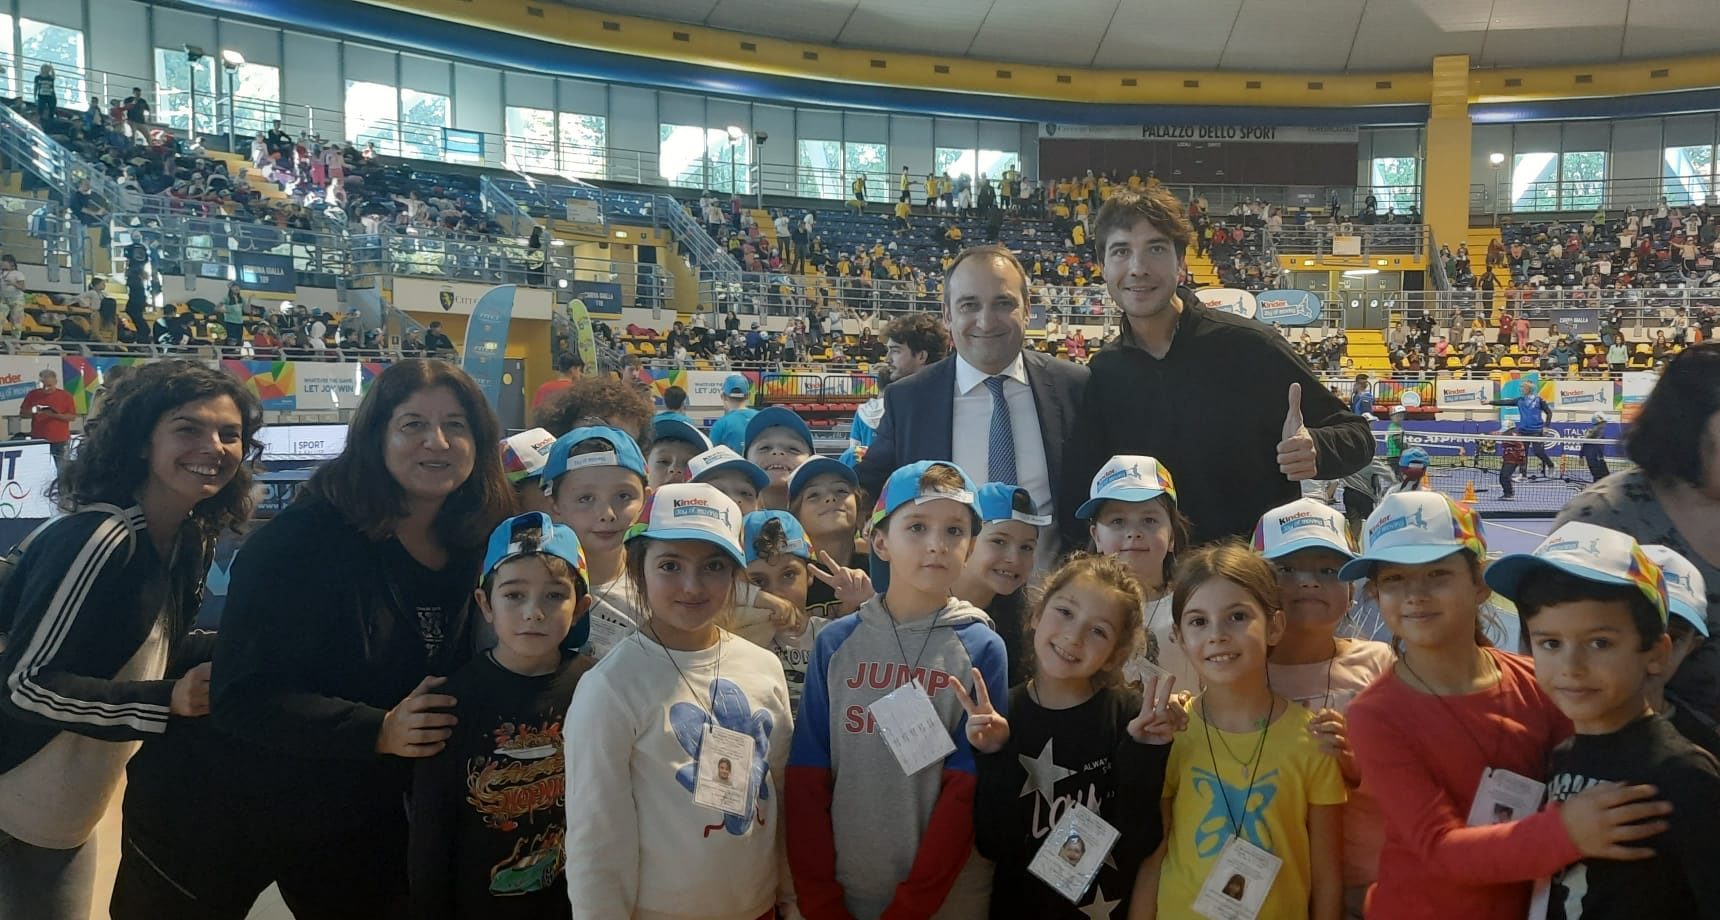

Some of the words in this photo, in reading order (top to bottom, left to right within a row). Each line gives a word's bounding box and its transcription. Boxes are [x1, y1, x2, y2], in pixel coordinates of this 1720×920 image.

[1142, 125, 1194, 139] PALAZZO
[1199, 125, 1236, 139] DELLO
[1240, 126, 1276, 140] SPORT
[304, 384, 319, 393] LET
[321, 384, 337, 393] JOY
[338, 384, 354, 393] WIN
[298, 440, 324, 449] SPORT
[673, 498, 708, 507] Kinder
[1279, 511, 1311, 526] Kinder
[846, 661, 951, 698] JUMP
